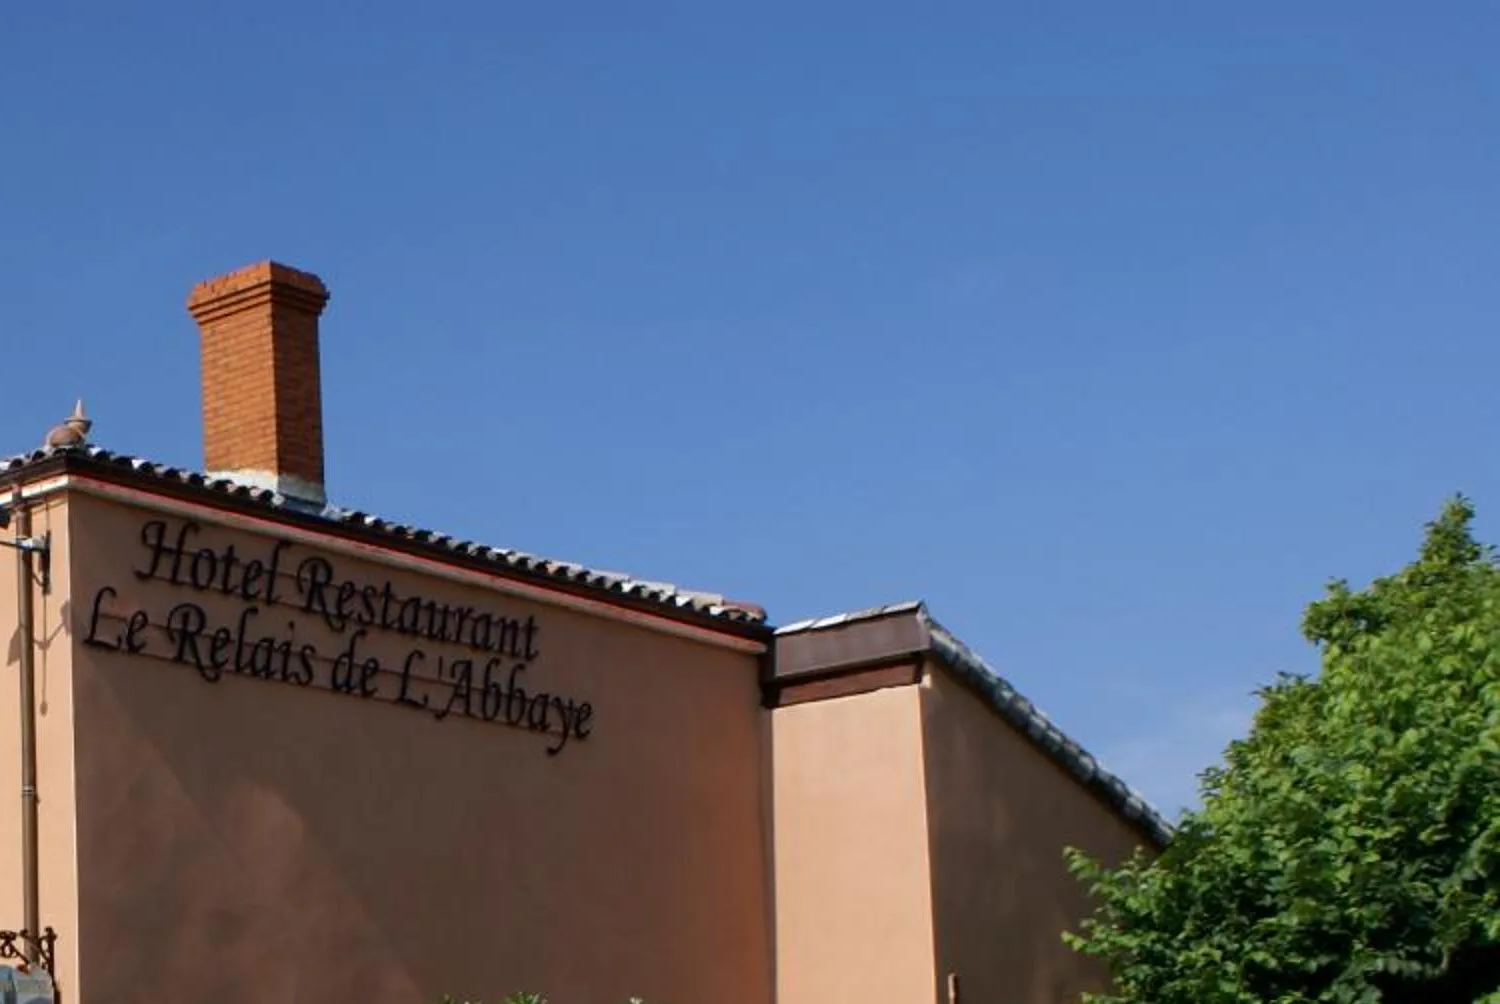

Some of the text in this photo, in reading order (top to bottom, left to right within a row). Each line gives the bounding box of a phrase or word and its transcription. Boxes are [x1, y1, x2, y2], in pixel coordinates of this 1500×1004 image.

[133, 519, 539, 662] Hotel Restaurant
[83, 585, 594, 756] Le Relais de L'Abbaye
